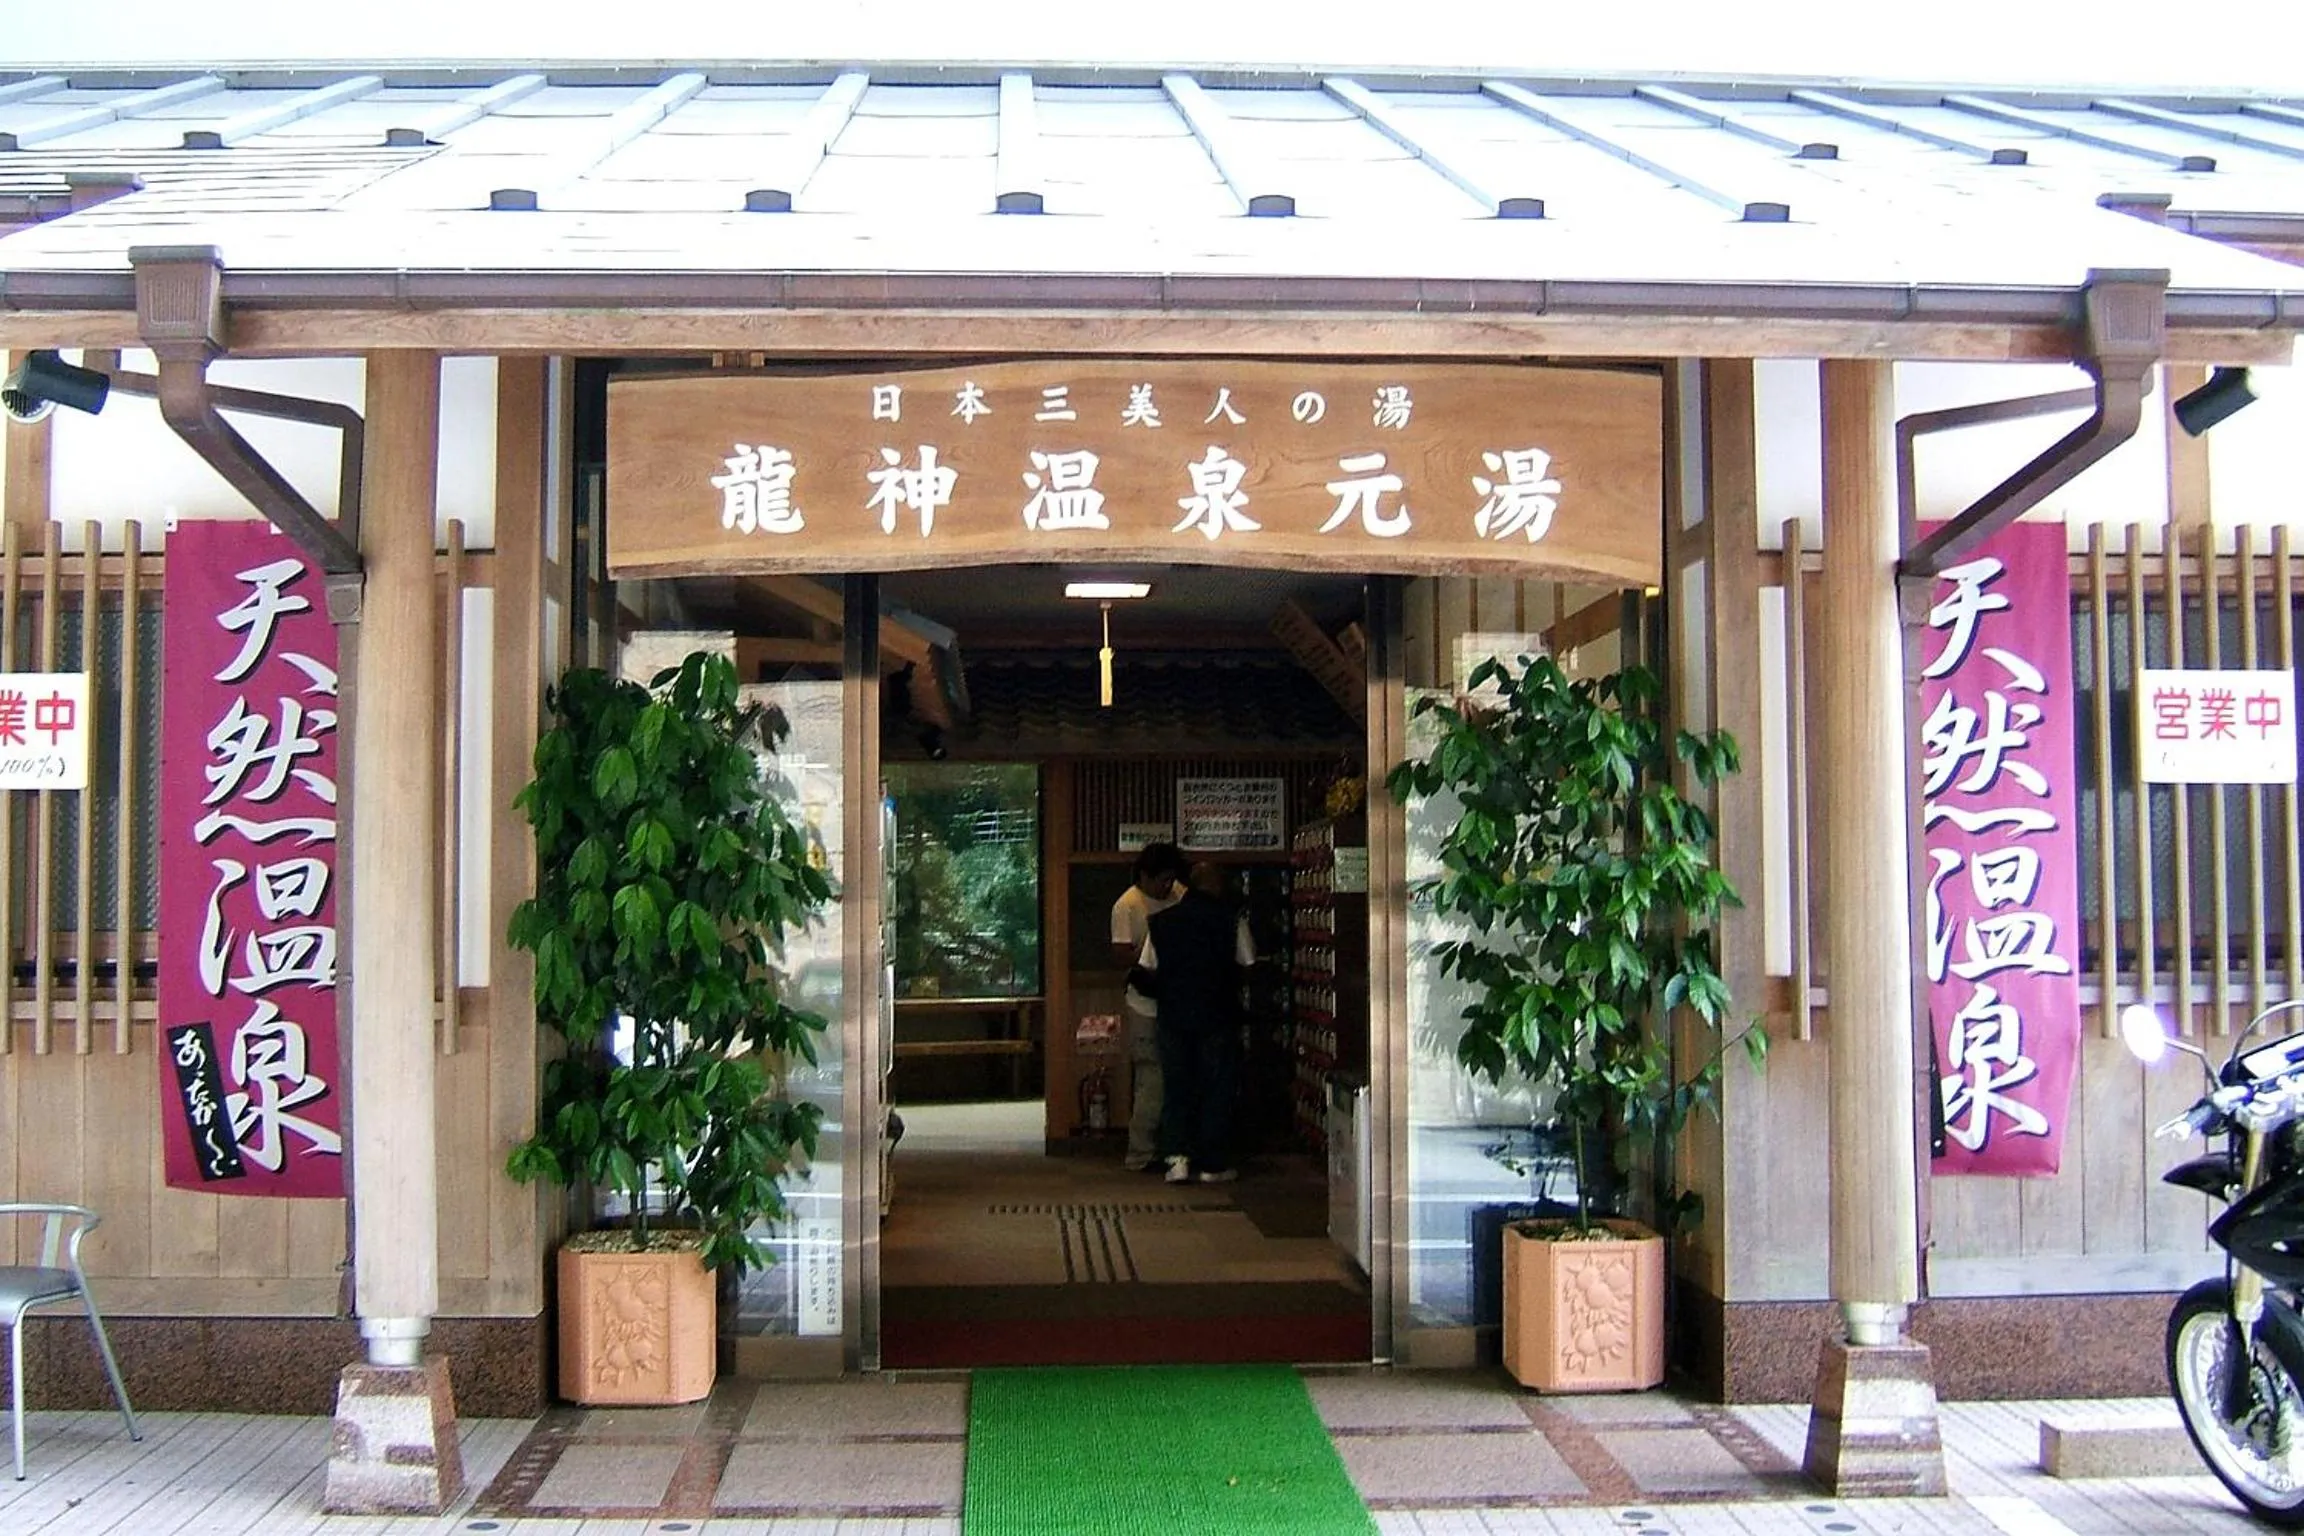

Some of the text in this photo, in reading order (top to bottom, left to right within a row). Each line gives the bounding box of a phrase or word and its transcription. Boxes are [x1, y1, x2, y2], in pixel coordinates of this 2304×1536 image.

[872, 380, 1413, 429] 日本三美人の湯
[710, 442, 1562, 543] 龍神温泉元湯
[2153, 686, 2282, 741] 営業中
[195, 557, 341, 1174] 天然温泉
[1924, 556, 2072, 1152] 天然温泉
